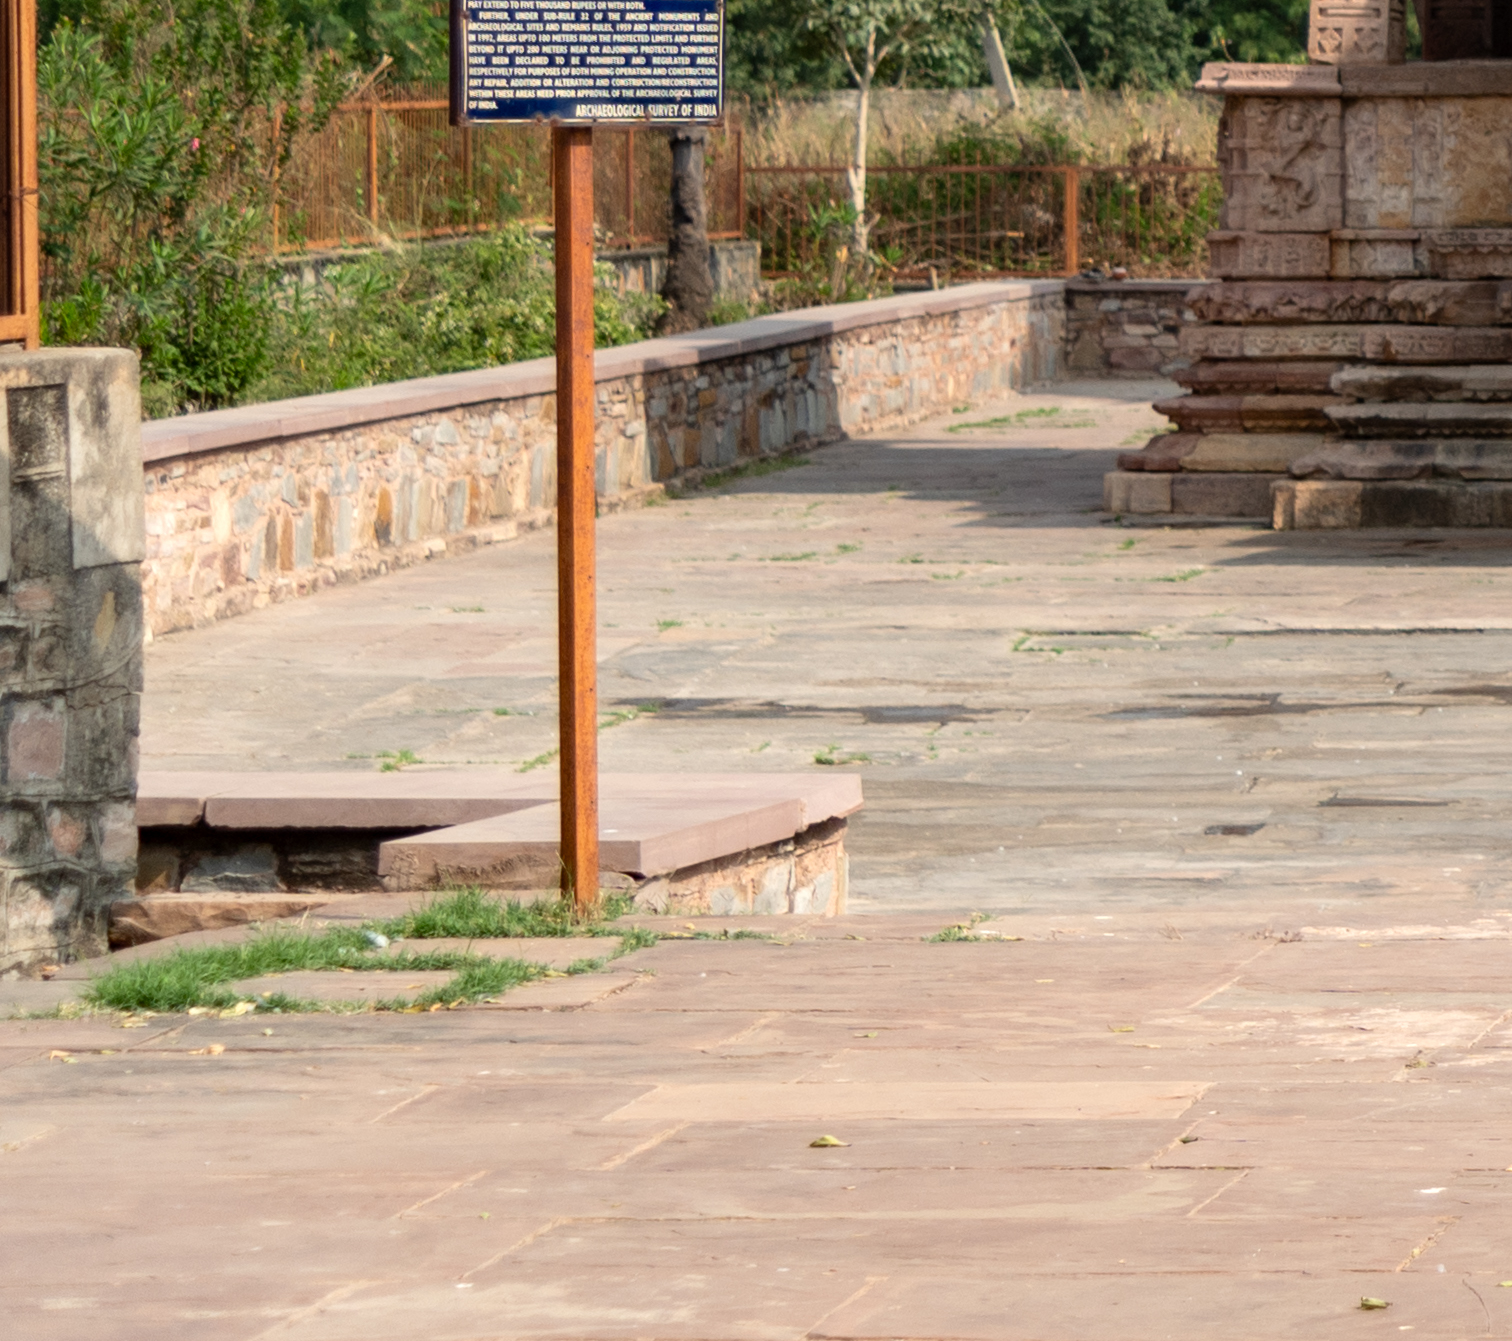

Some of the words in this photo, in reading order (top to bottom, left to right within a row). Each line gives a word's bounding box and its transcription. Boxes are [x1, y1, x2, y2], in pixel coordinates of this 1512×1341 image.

[468, 1, 482, 9] MAY
[483, 1, 509, 9] EXTEND
[510, 1, 519, 9] TO
[521, 1, 535, 9] FIVE
[536, 1, 571, 9] THOUSAND
[572, 1, 596, 10] RUPEES
[597, 1, 606, 10] OR
[608, 1, 625, 10] WITH
[515, 12, 538, 20] UNDER
[581, 12, 590, 21] 32
[594, 12, 603, 21] OF
[609, 13, 621, 21] THE
[626, 13, 653, 21] ANCIENT
[659, 13, 700, 21] MONUMENTS
[705, 13, 718, 21] AND
[468, 23, 524, 32] ARCHAEOLOGICAL
[527, 23, 544, 32] SITES
[545, 23, 560, 32] AND
[562, 23, 590, 32] REMAINS
[617, 24, 632, 32] 1959
[634, 24, 648, 32] AND
[650, 24, 695, 32] NOTIFICATION
[696, 24, 718, 32] ISSUED
[468, 34, 476, 42] IN
[497, 34, 517, 43] AREAS
[518, 34, 536, 43] UPTO
[552, 34, 578, 43] METERS
[579, 34, 598, 43] FROM
[599, 35, 611, 43] THE
[613, 35, 650, 43] PROTECTED
[651, 35, 673, 43] LIMITS
[674, 35, 688, 43] AND
[690, 35, 718, 43] FURTHER
[468, 45, 495, 54] BEYOND
[497, 45, 504, 54] IT
[506, 45, 524, 54] UPTO
[542, 45, 568, 54] METERS
[570, 46, 588, 54] NEAR
[590, 46, 600, 54] OR
[602, 46, 638, 54] ADJOINING
[640, 46, 679, 54] PROTECTED
[681, 46, 718, 54] MONUMENT
[469, 56, 486, 65] HAVE
[492, 56, 509, 65] BEEN
[515, 56, 549, 65] DECLARED
[555, 56, 564, 65] TO
[571, 56, 580, 65] BE
[586, 57, 626, 65] PROHIBITED
[631, 57, 646, 65] AND
[652, 57, 690, 65] REGULATED
[469, 67, 513, 76] RESPECTIVELY
[514, 68, 527, 76] FOR
[528, 68, 561, 76] PURPOSES
[561, 68, 570, 76] OF
[571, 68, 589, 76] BOTH
[590, 68, 614, 76] MINING
[615, 68, 652, 76] OPERATION
[653, 68, 667, 76] AND
[469, 79, 482, 87] ANY
[510, 79, 542, 87] ADDITION
[543, 79, 553, 87] OR
[554, 79, 594, 87] ALTERATION
[595, 79, 609, 87] AND
[469, 90, 493, 98] WITHIN
[494, 90, 515, 98] THESE
[516, 90, 536, 98] AREAS
[537, 90, 554, 98] NEED
[555, 90, 576, 98] PRIOR
[577, 90, 610, 98] APPROVAL
[611, 90, 620, 98] OF
[622, 90, 635, 98] THE
[636, 90, 692, 98] ARCHAEOLOGICAL
[693, 89, 718, 98] SURVEY
[469, 101, 477, 109] OF
[576, 104, 645, 117] ARCHAEOLOGICAL
[647, 104, 678, 117] SURVEY
[680, 104, 692, 117] OF
[694, 104, 717, 117] INDIA
